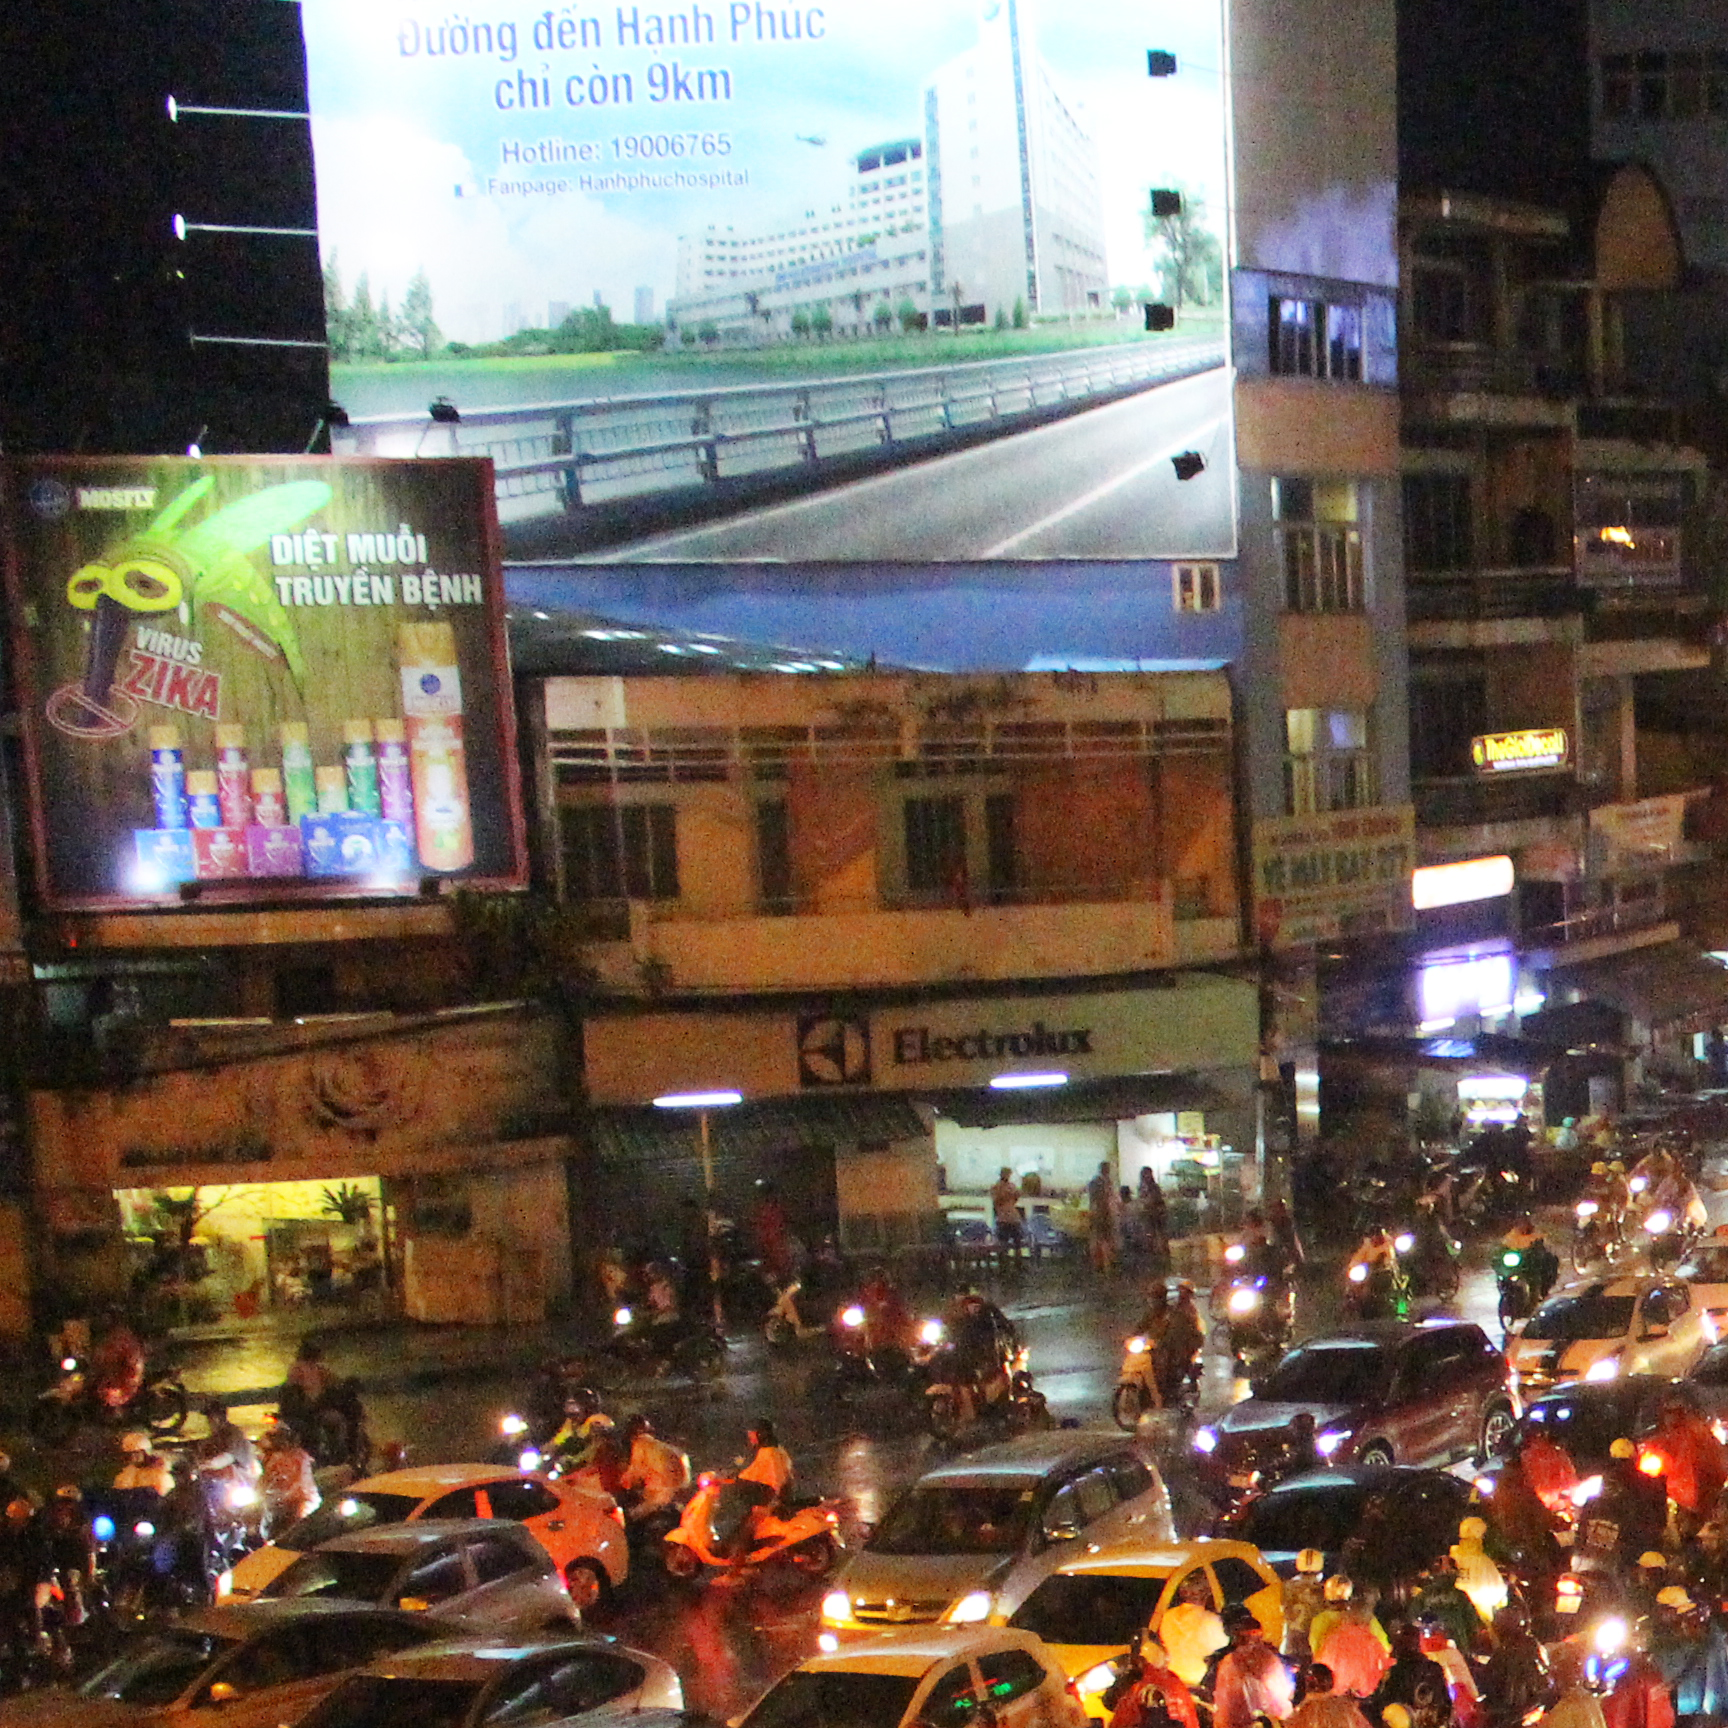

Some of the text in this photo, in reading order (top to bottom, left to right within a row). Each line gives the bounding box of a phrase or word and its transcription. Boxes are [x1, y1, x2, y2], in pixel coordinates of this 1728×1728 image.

[397, 14, 519, 62] Đường
[533, 3, 601, 53] đến
[615, 3, 715, 56] Hạnh
[494, 61, 732, 111] chỉ còn 9km
[502, 133, 732, 165] Hotline: 19006765
[488, 169, 749, 197] Fanpage: Hanhphuchospital
[271, 528, 338, 571] DIỆT
[275, 566, 483, 610] TRUYỀN BỆNH
[136, 625, 203, 664] VIRUS
[122, 649, 222, 720] ZIKA
[893, 1021, 1094, 1064] Electrolux
